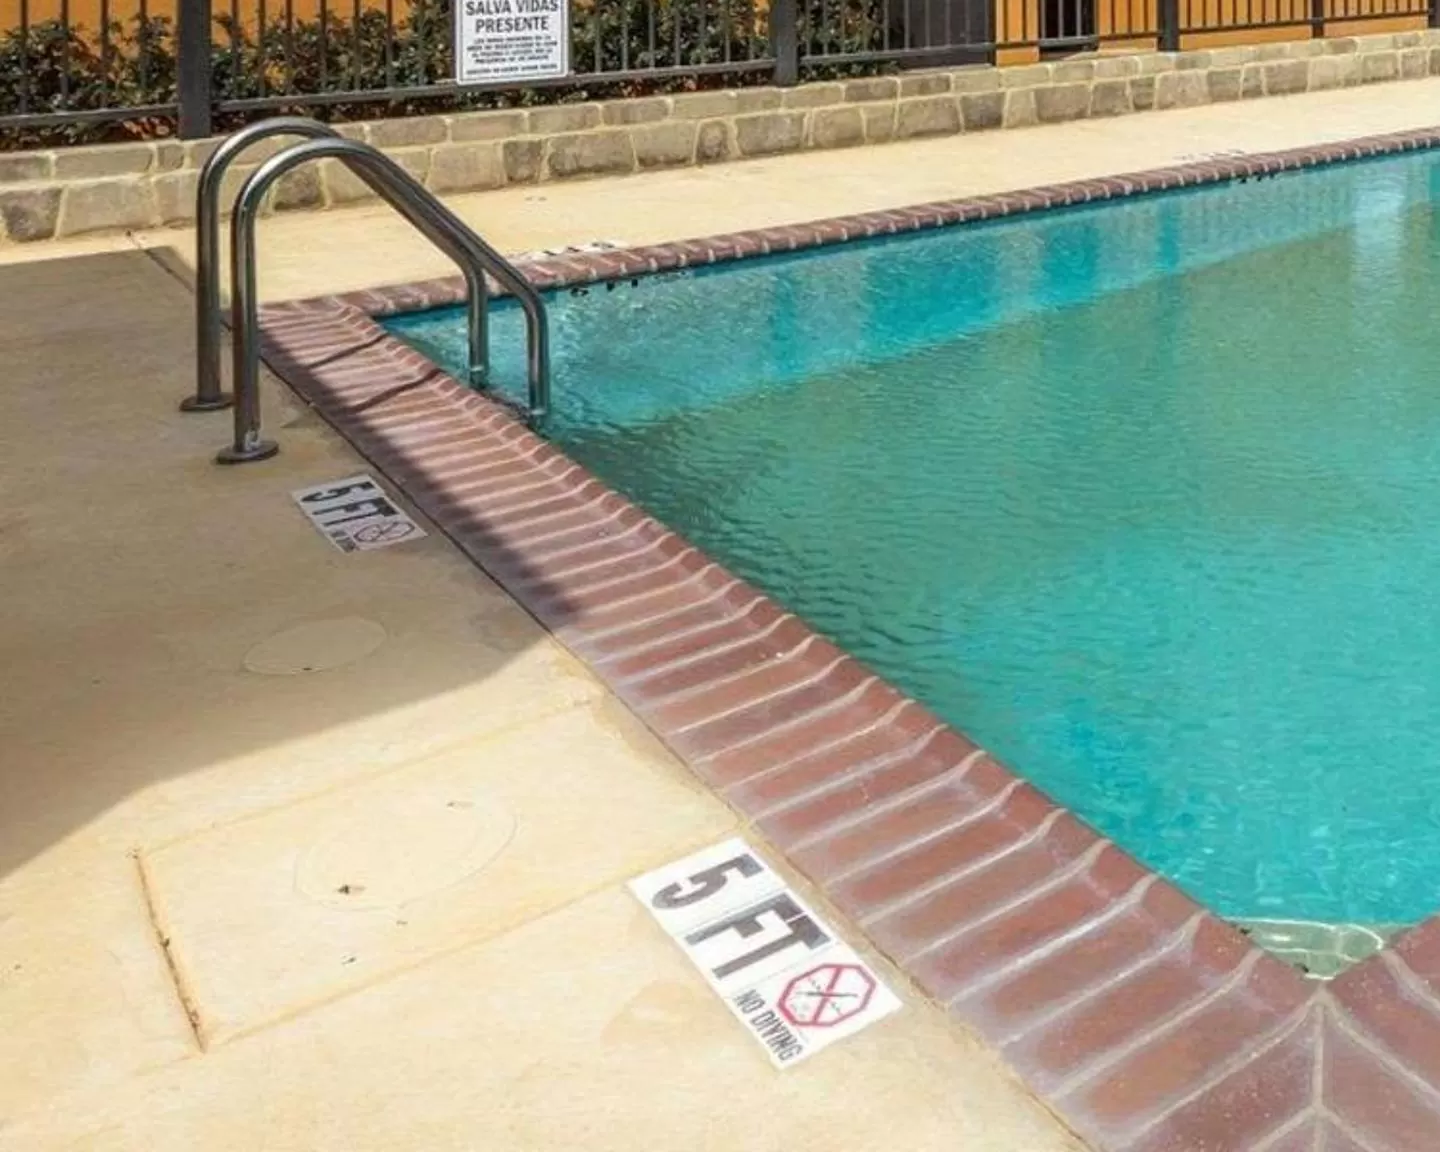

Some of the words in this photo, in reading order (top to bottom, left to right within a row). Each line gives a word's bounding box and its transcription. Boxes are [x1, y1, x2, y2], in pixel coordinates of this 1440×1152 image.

[466, 0, 511, 16] SALVA
[475, 16, 549, 33] PRESENTE
[302, 481, 376, 502] 5
[312, 497, 398, 527] FT
[651, 853, 765, 911] 5
[684, 892, 832, 980] FT
[733, 988, 766, 1015] NO
[751, 1009, 804, 1063] DIVING
